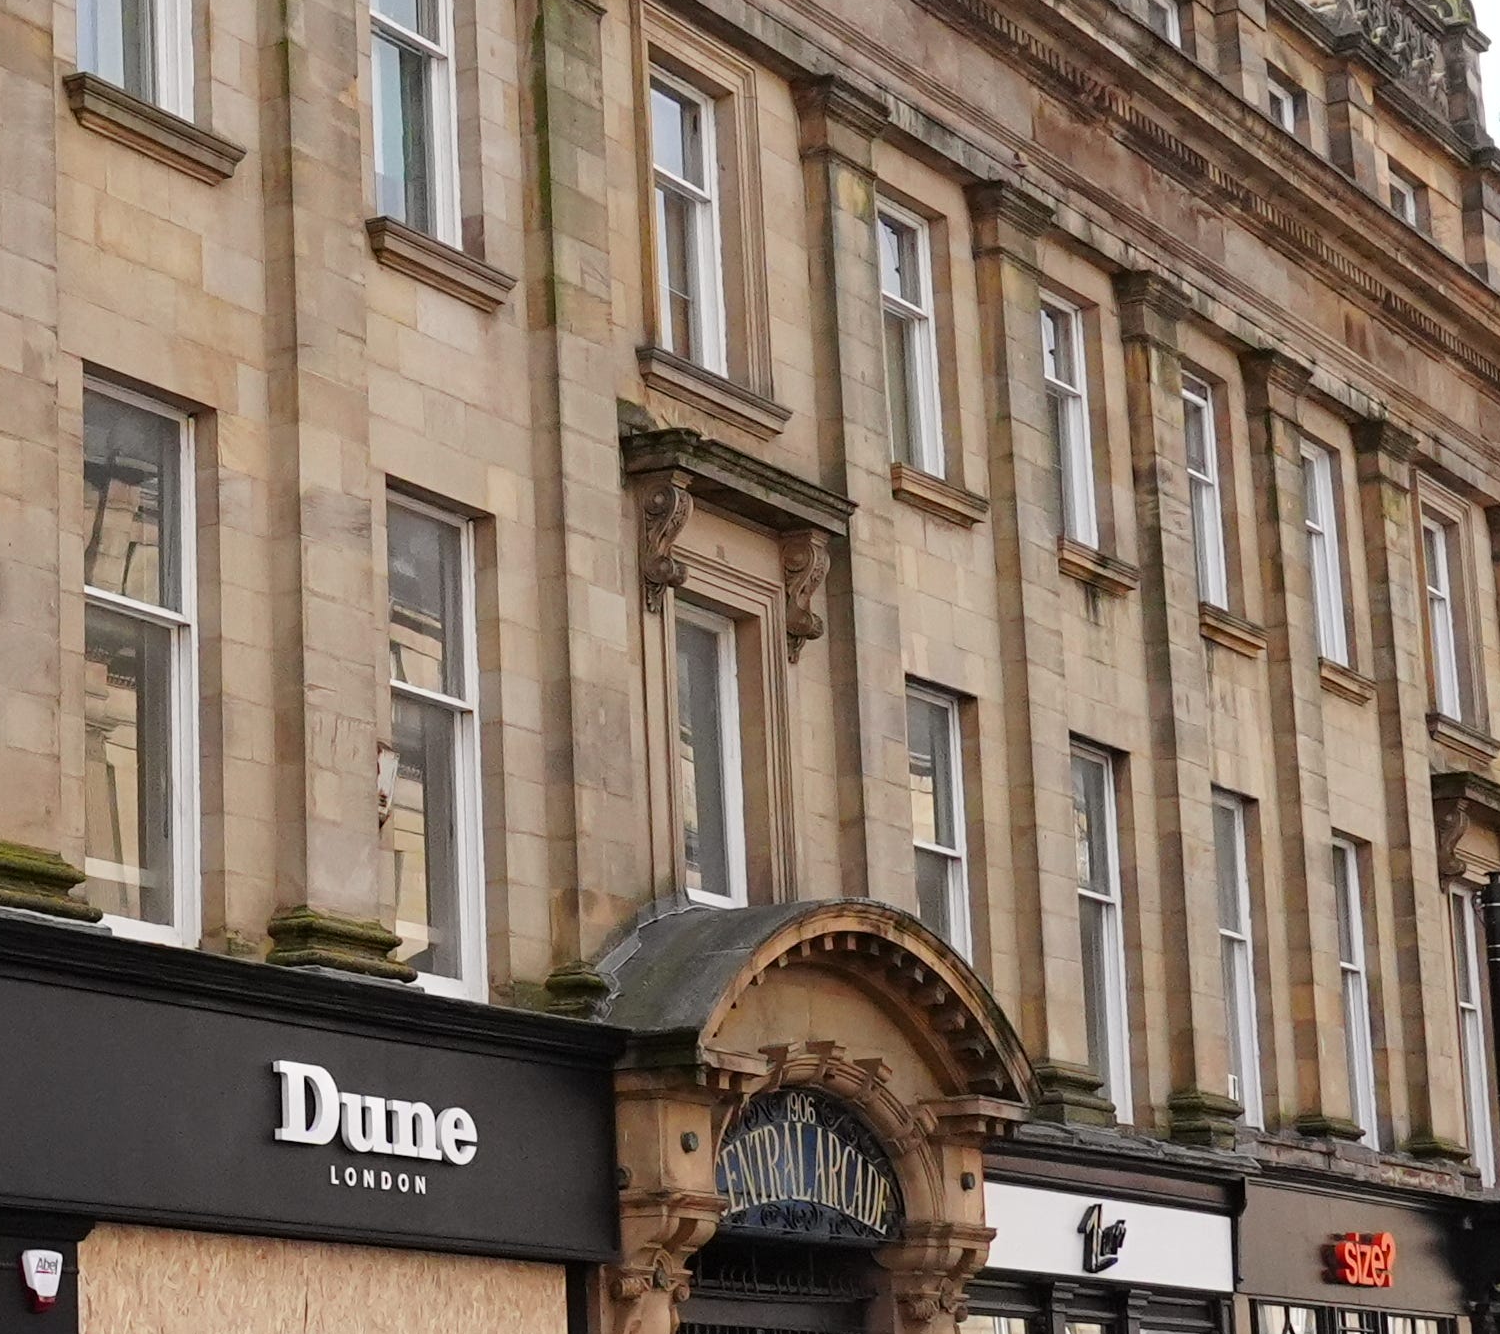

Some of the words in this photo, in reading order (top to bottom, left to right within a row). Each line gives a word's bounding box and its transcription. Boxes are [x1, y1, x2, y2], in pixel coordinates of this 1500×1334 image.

[272, 1059, 478, 1166] Dune
[786, 1092, 816, 1124] 1906
[330, 1165, 427, 1195] LONDON
[720, 1121, 813, 1216] ENTRAL
[812, 1127, 891, 1236] ARCADE
[36, 1258, 59, 1275] Abel
[1336, 1231, 1397, 1288] size?
